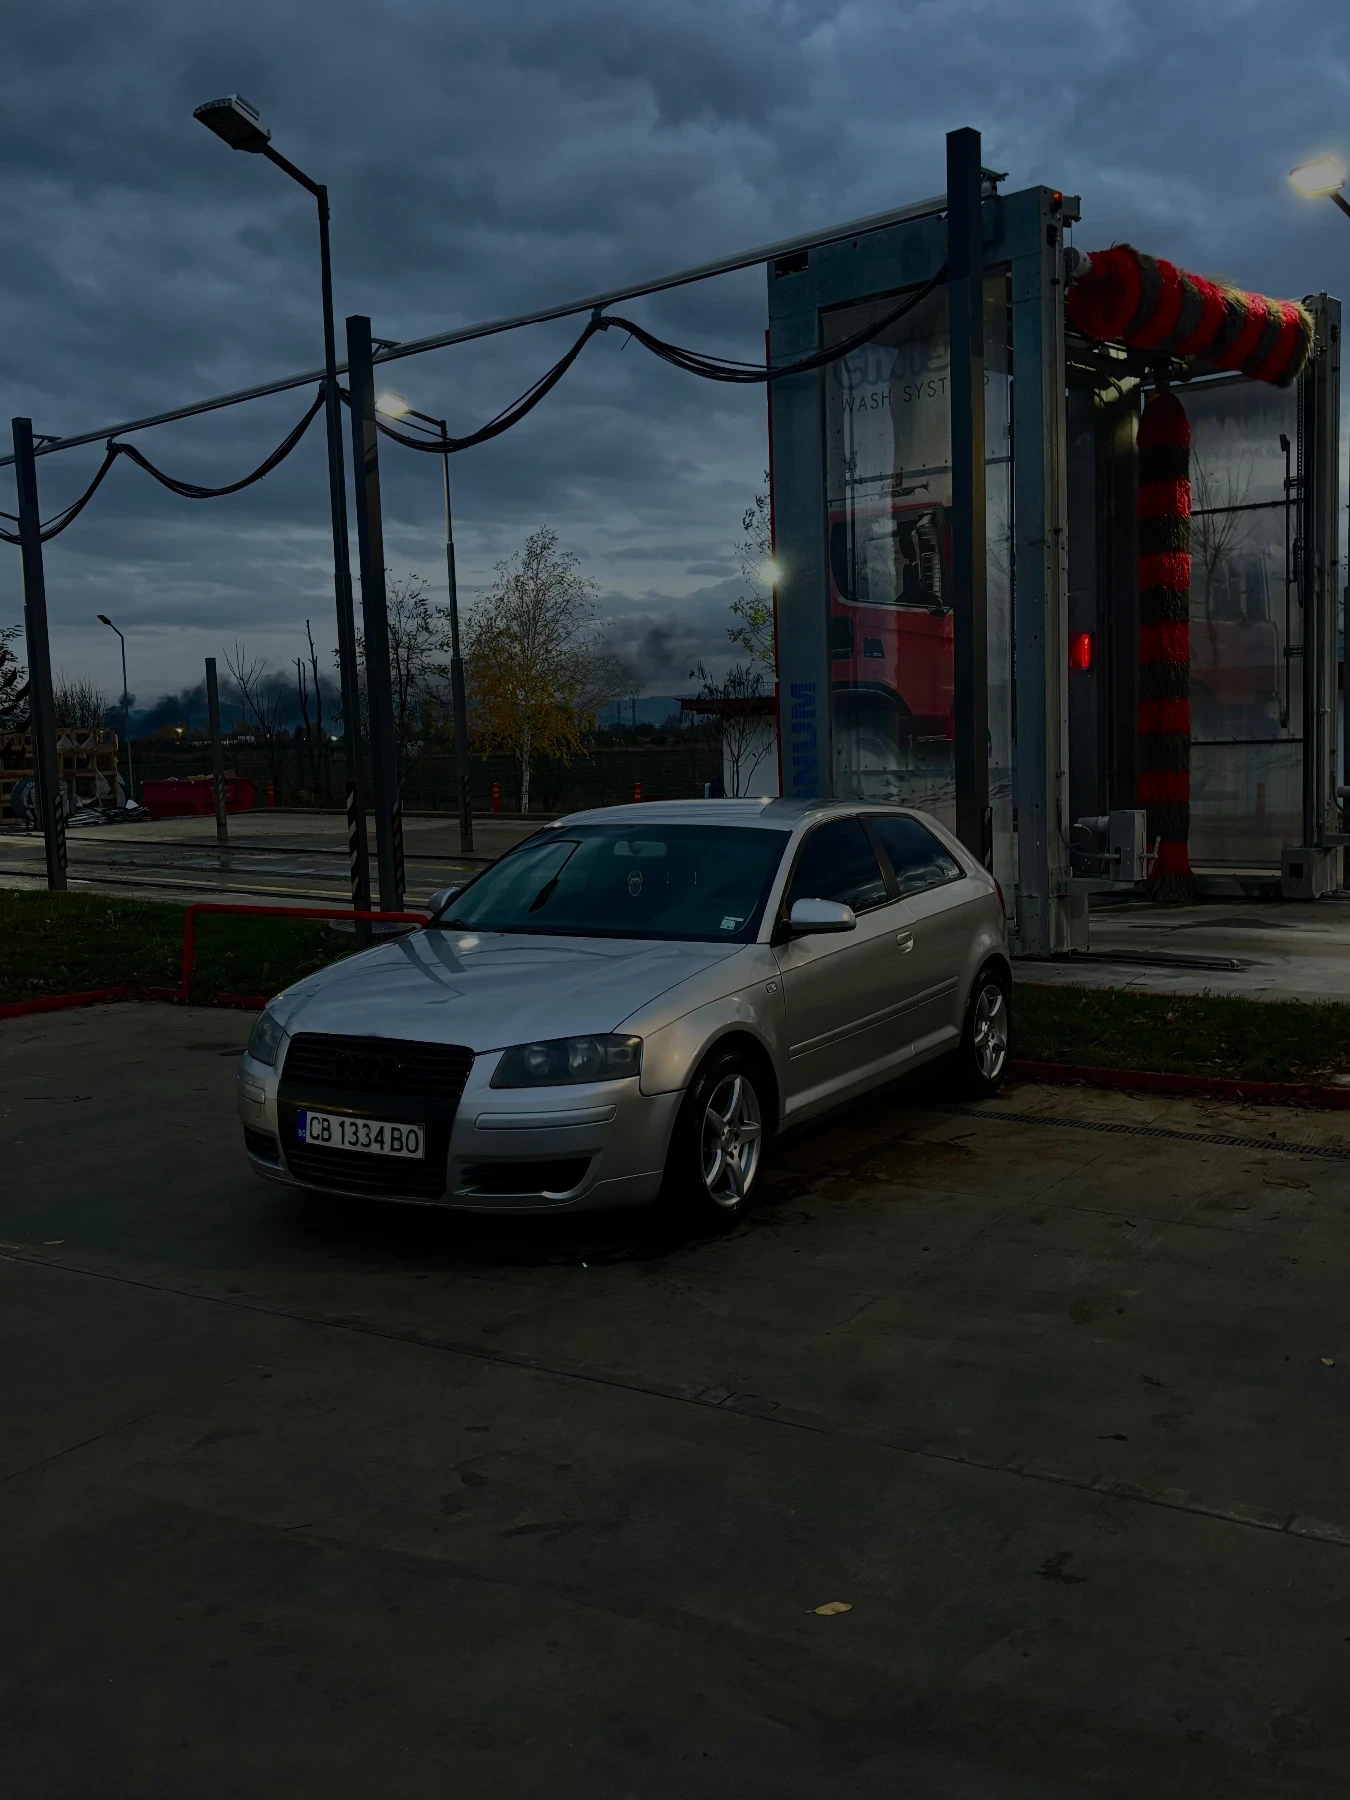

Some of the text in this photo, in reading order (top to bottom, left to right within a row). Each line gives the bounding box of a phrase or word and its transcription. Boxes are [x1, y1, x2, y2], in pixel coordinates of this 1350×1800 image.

[842, 389, 892, 413] WASH
[309, 1116, 419, 1153] CB 1334 BO
